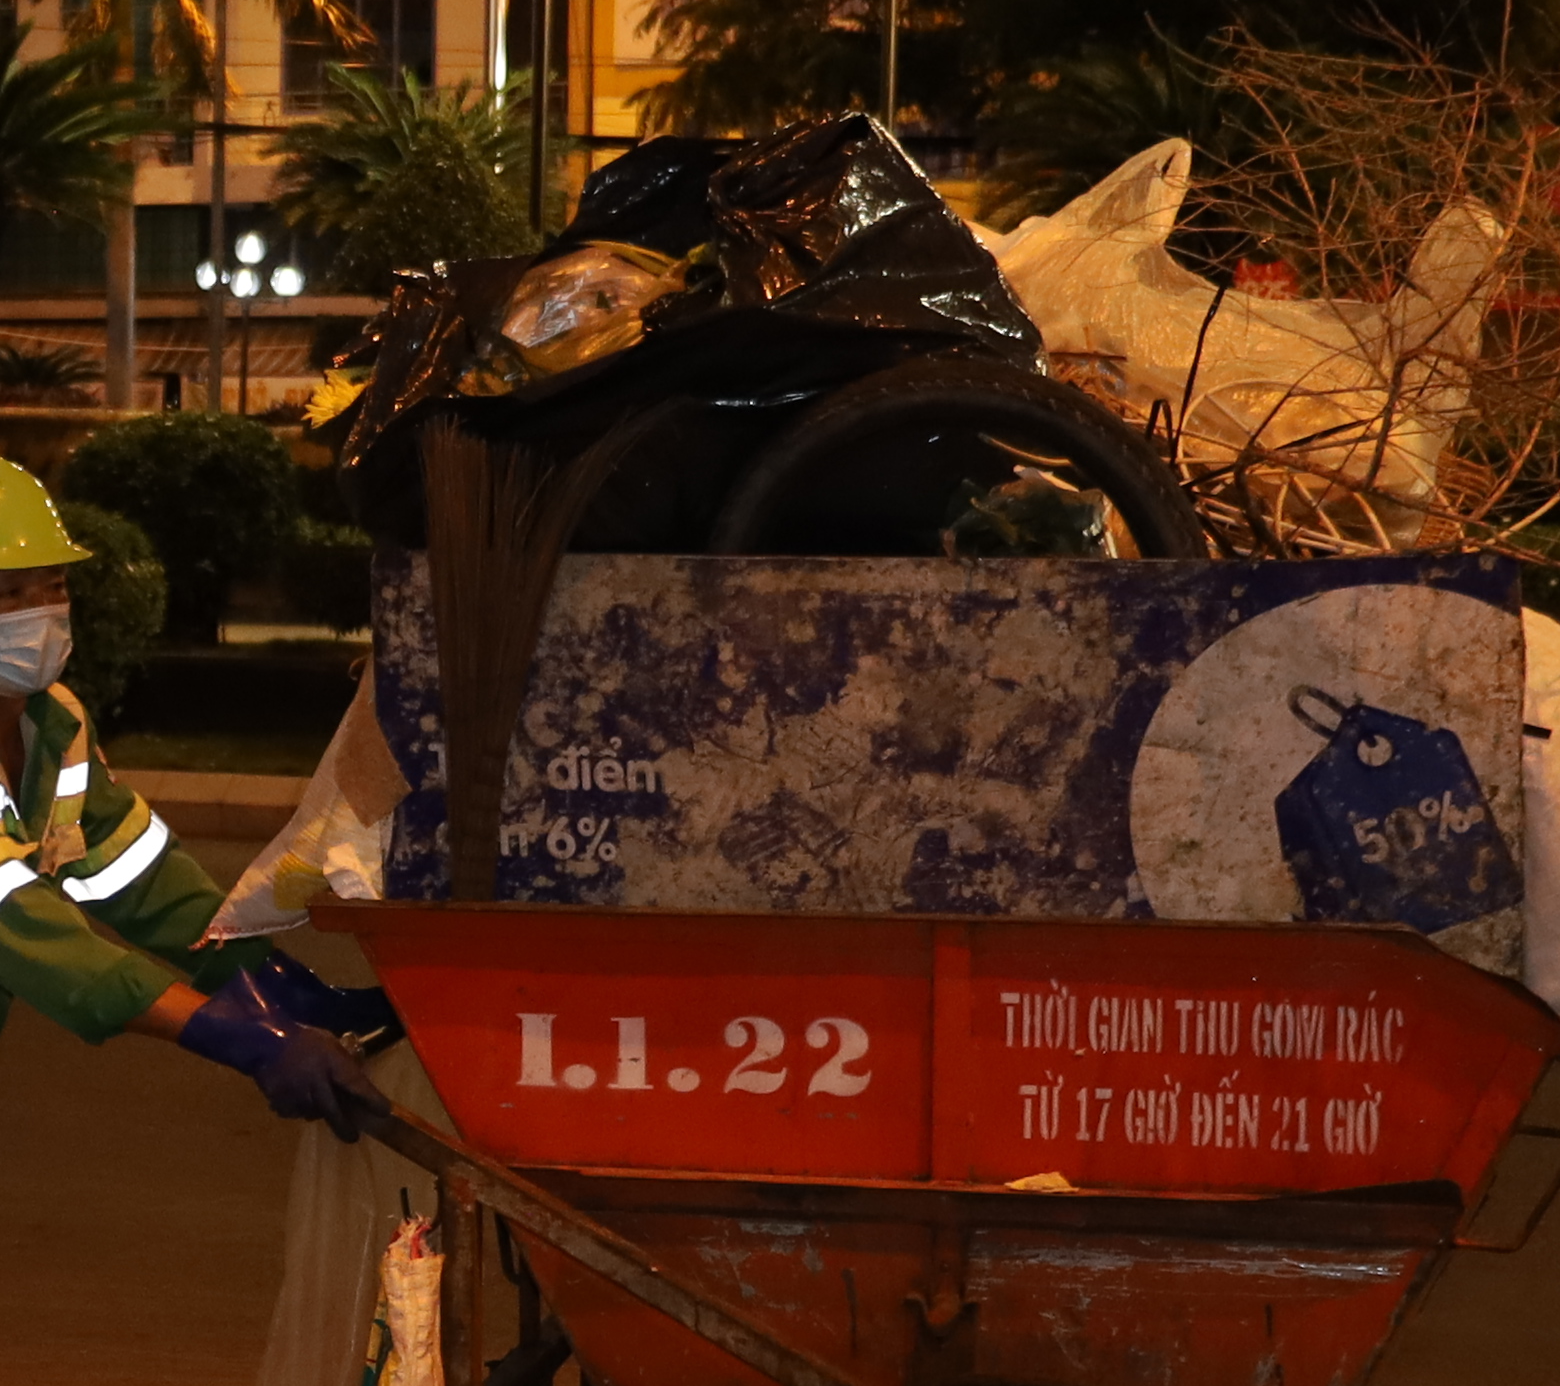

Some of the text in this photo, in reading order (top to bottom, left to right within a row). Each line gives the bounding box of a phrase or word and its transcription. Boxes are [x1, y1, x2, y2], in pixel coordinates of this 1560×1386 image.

[999, 977, 1405, 1064] THỜI GIAN THU GOM RÁC
[1018, 1069, 1383, 1156] TỪ 17 GIỜ ĐẾN 21 GIỜ
